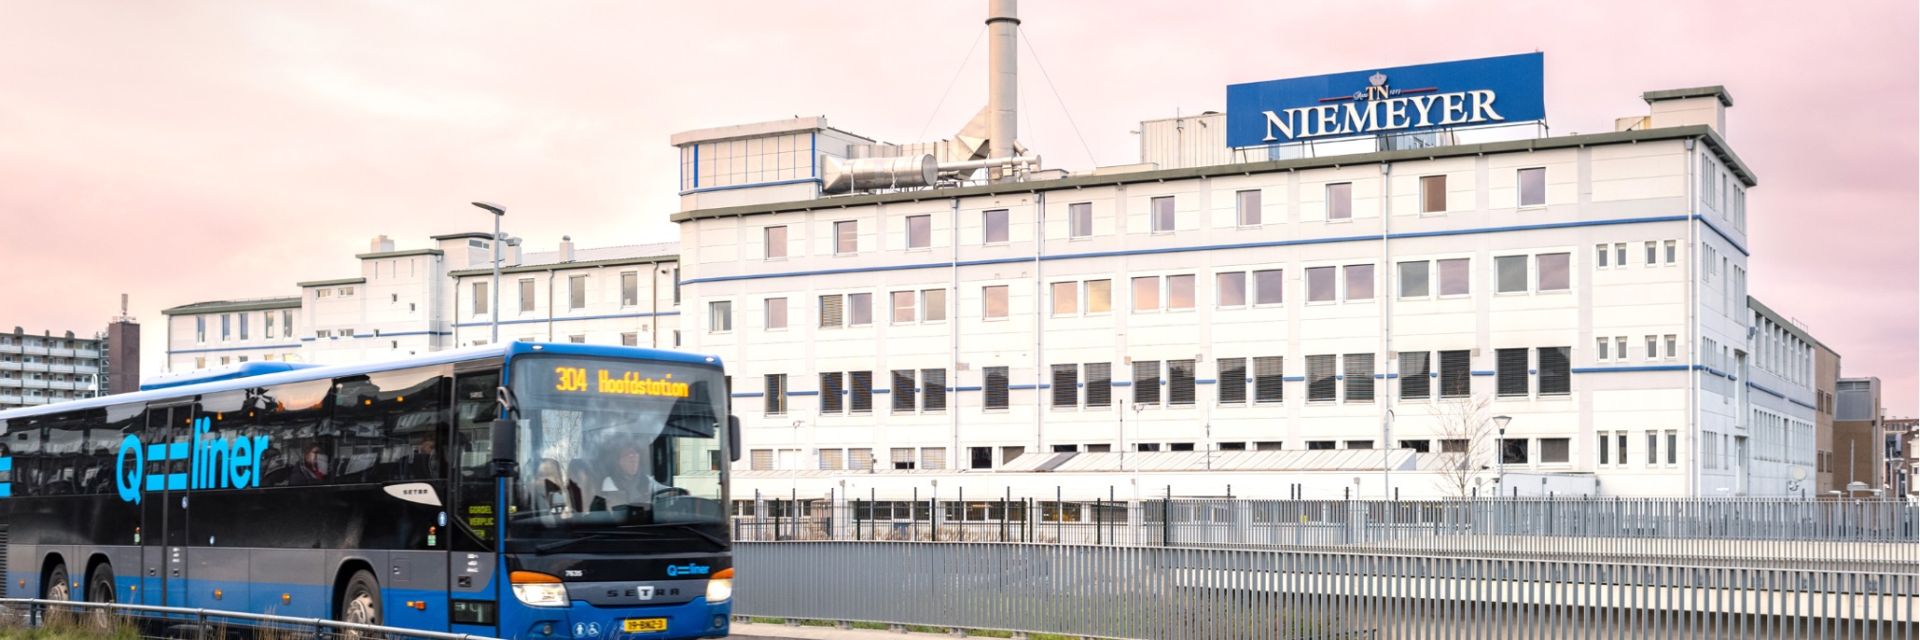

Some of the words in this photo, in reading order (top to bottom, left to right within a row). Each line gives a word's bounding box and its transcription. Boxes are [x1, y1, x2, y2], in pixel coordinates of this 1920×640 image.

[1366, 85, 1389, 100] TN
[1262, 89, 1504, 142] NIEMEYER
[555, 367, 588, 392] 304
[598, 369, 689, 398] Hoofdstation
[607, 588, 680, 598] SETRA
